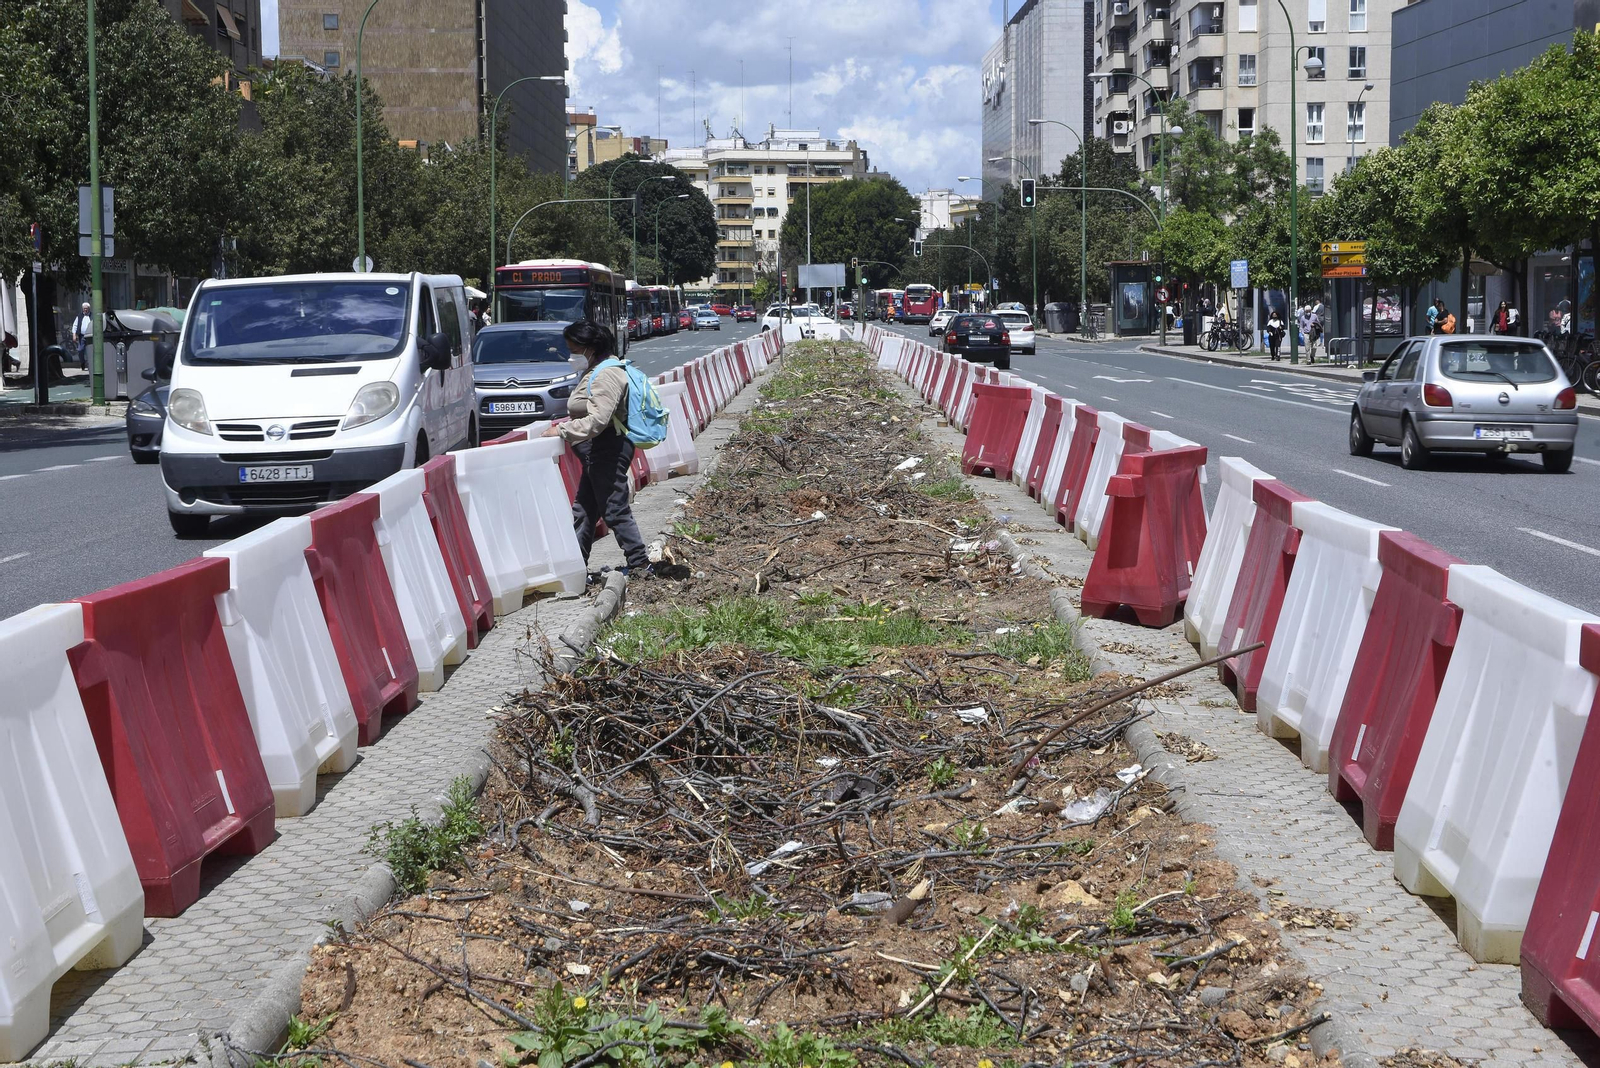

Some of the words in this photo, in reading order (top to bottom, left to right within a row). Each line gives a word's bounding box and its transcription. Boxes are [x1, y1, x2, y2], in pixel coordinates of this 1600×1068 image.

[512, 272, 523, 283] C1
[531, 271, 562, 282] PRADO
[494, 403, 516, 411] 5969
[517, 402, 533, 411] KXY
[250, 468, 280, 481] 6428
[285, 467, 309, 479] FTJ
